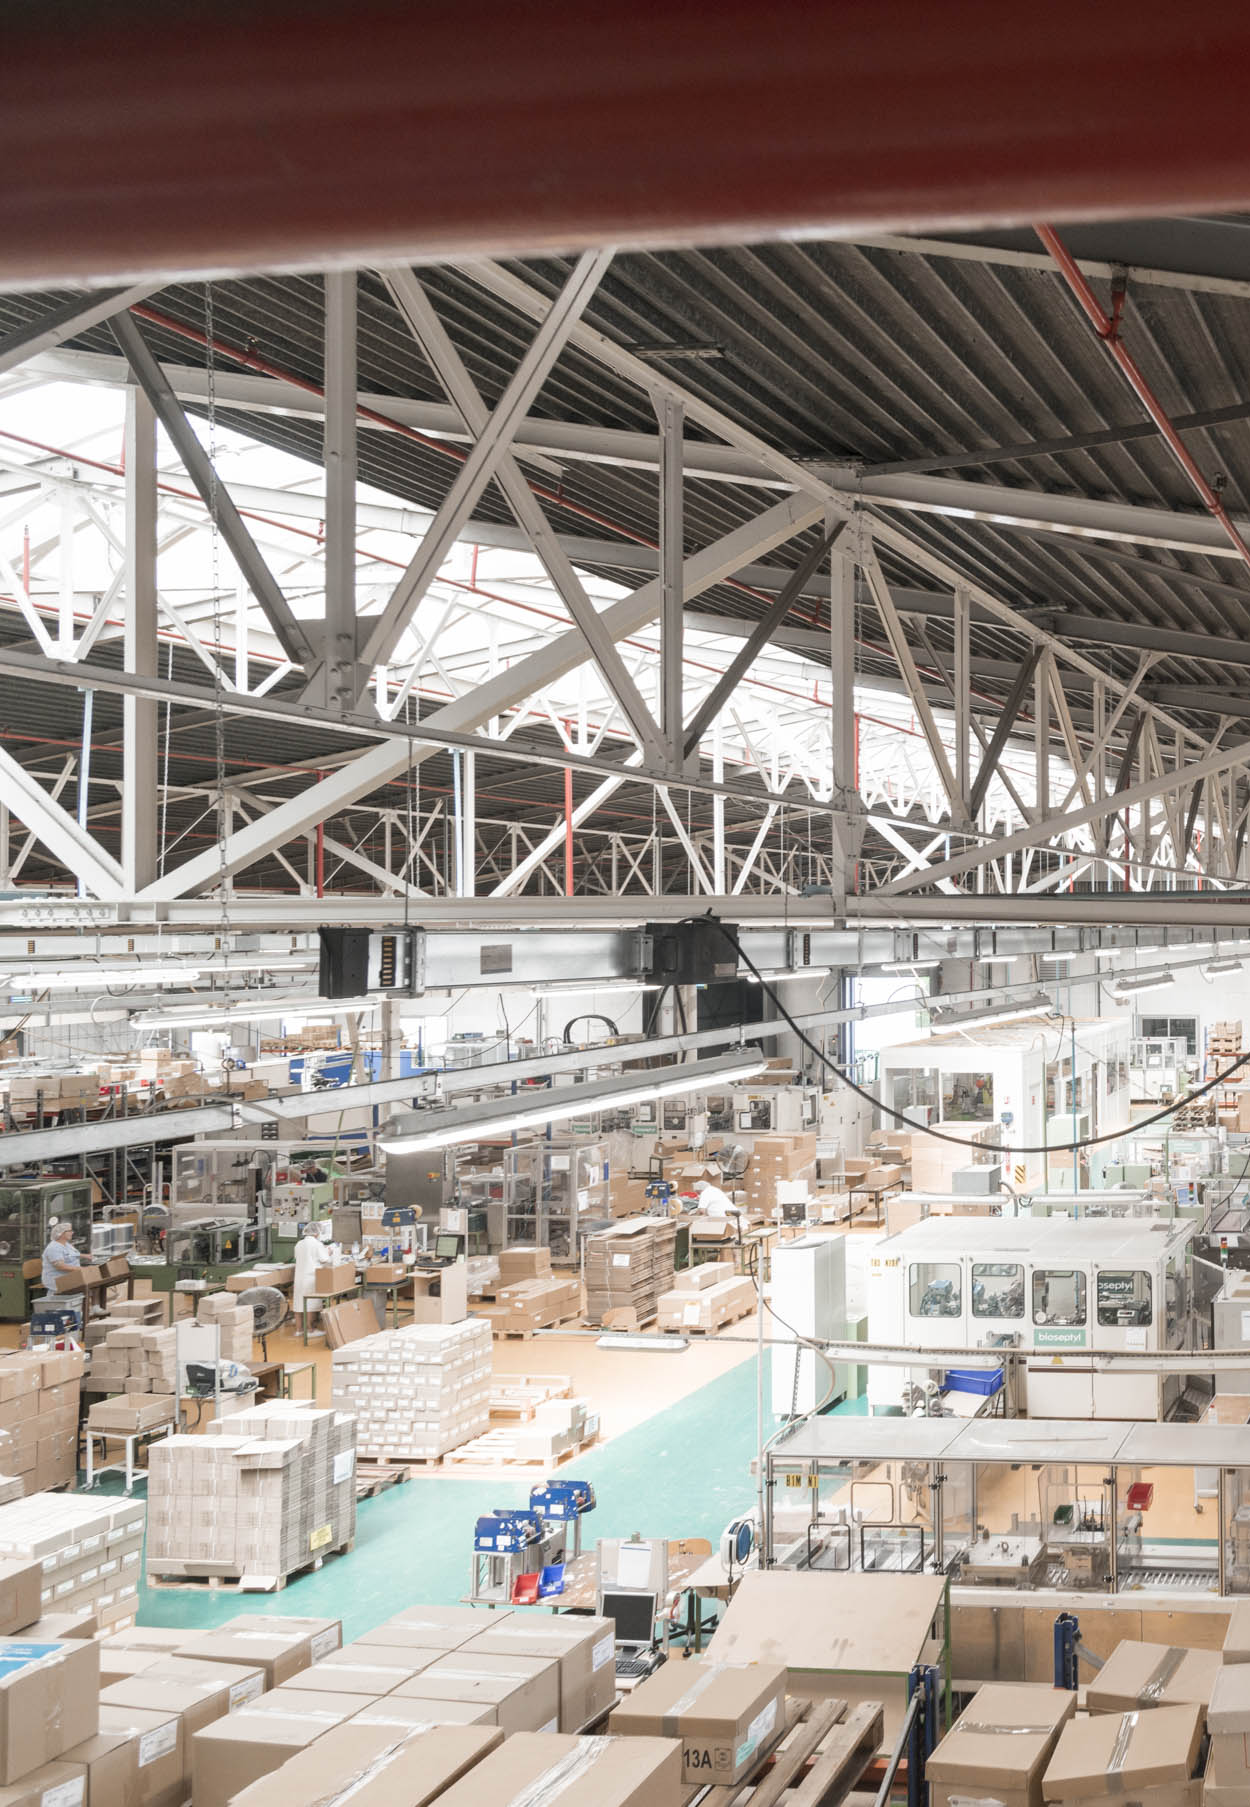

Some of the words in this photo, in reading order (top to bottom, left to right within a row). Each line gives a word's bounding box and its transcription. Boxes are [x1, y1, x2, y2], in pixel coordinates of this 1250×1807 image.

[1098, 1281, 1133, 1292] oseptyl
[1039, 1332, 1081, 1343] bioseptyl
[683, 1749, 712, 1769] 13A
